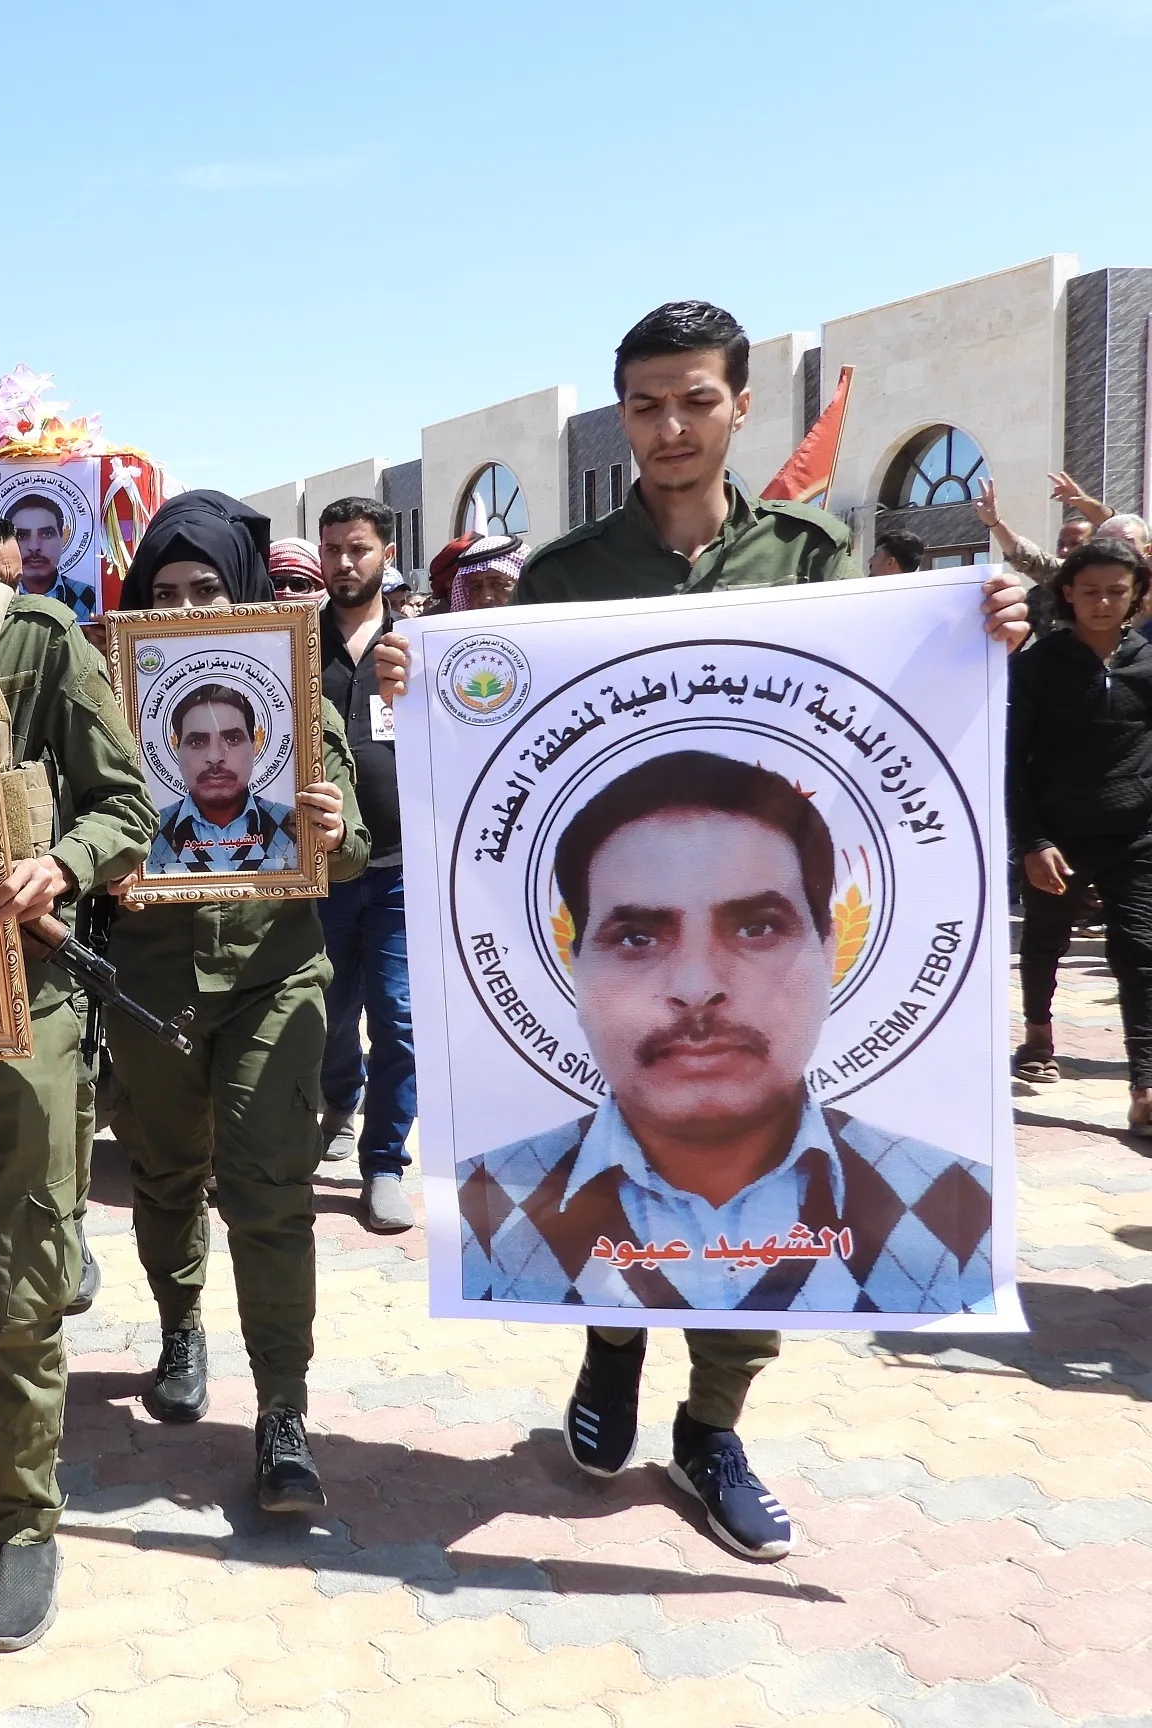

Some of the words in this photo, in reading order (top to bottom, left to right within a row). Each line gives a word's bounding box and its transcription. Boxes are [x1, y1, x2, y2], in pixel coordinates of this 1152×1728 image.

[15, 475, 57, 486] الديمقراطية
[57, 481, 75, 500] المدنية
[185, 657, 245, 673] الديمقراطية
[245, 664, 270, 688] المدنية
[161, 668, 187, 691] لمنطقة
[600, 664, 804, 717] الديمقراطية
[147, 689, 166, 719] الطبقة
[267, 685, 286, 712] الإدارة
[519, 701, 606, 773] لمنطقة
[805, 683, 897, 763] المدنية
[277, 733, 291, 760] TEBQA
[880, 755, 947, 845] الإدارة
[474, 771, 536, 863] الطبقة
[184, 839, 214, 852] عبود
[218, 833, 264, 849] الشهيد
[470, 932, 559, 1062] RÊVEBERIYA
[807, 1067, 839, 1093] YA
[832, 1000, 927, 1078] HERÊMA
[909, 920, 963, 997] TEBQA
[592, 1235, 693, 1270] عبود
[703, 1222, 853, 1269] الشهيد
